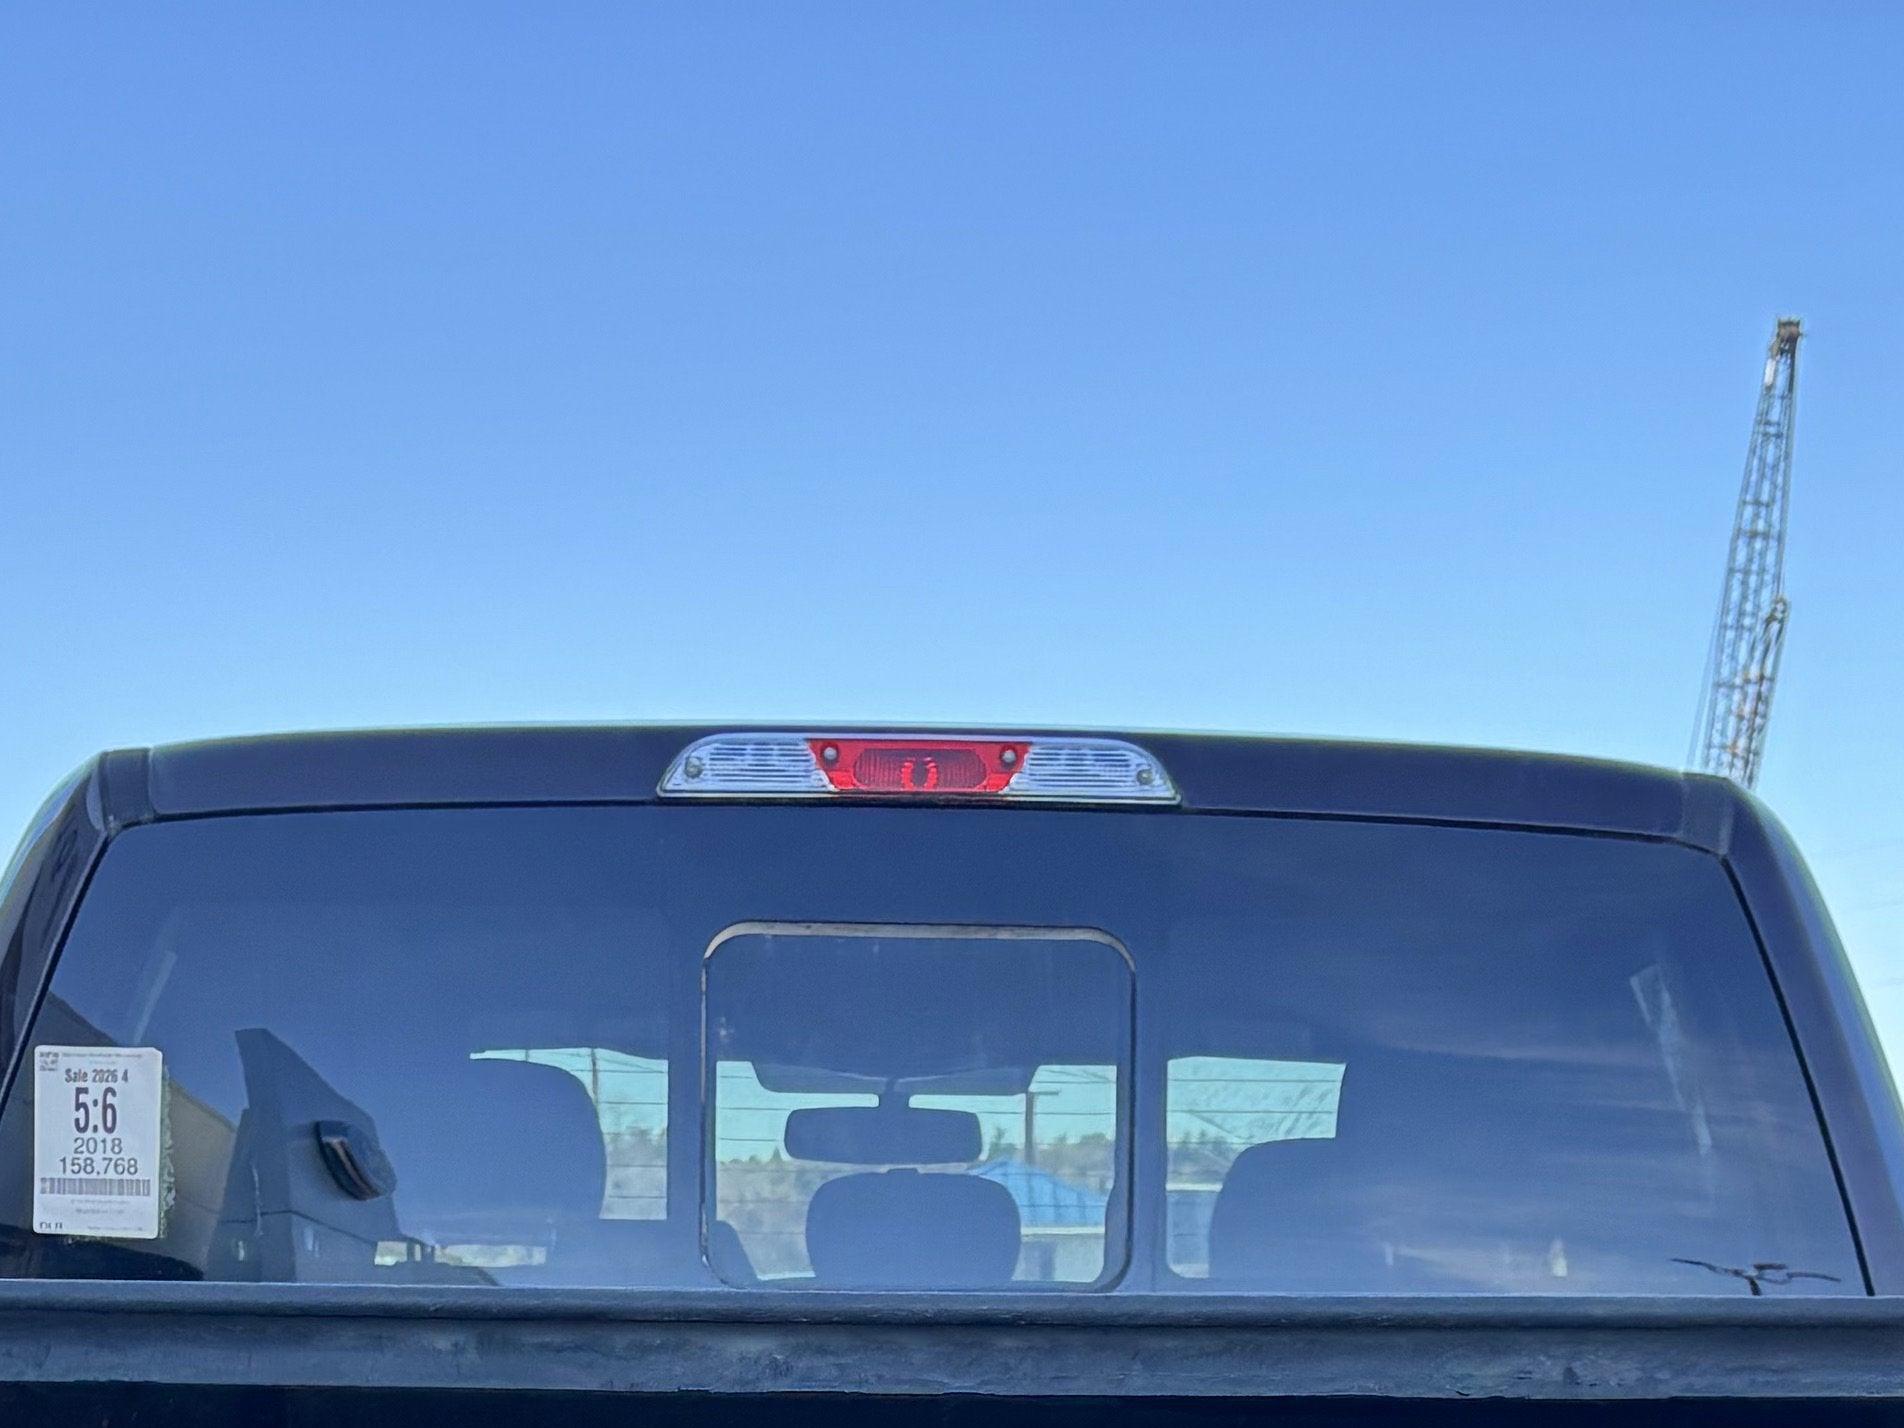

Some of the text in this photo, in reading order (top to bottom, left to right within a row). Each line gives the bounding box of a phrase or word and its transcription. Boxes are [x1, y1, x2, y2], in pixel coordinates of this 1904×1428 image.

[65, 1068, 88, 1083] Sale
[74, 1087, 117, 1134] 5:6
[73, 1137, 123, 1155] 2018
